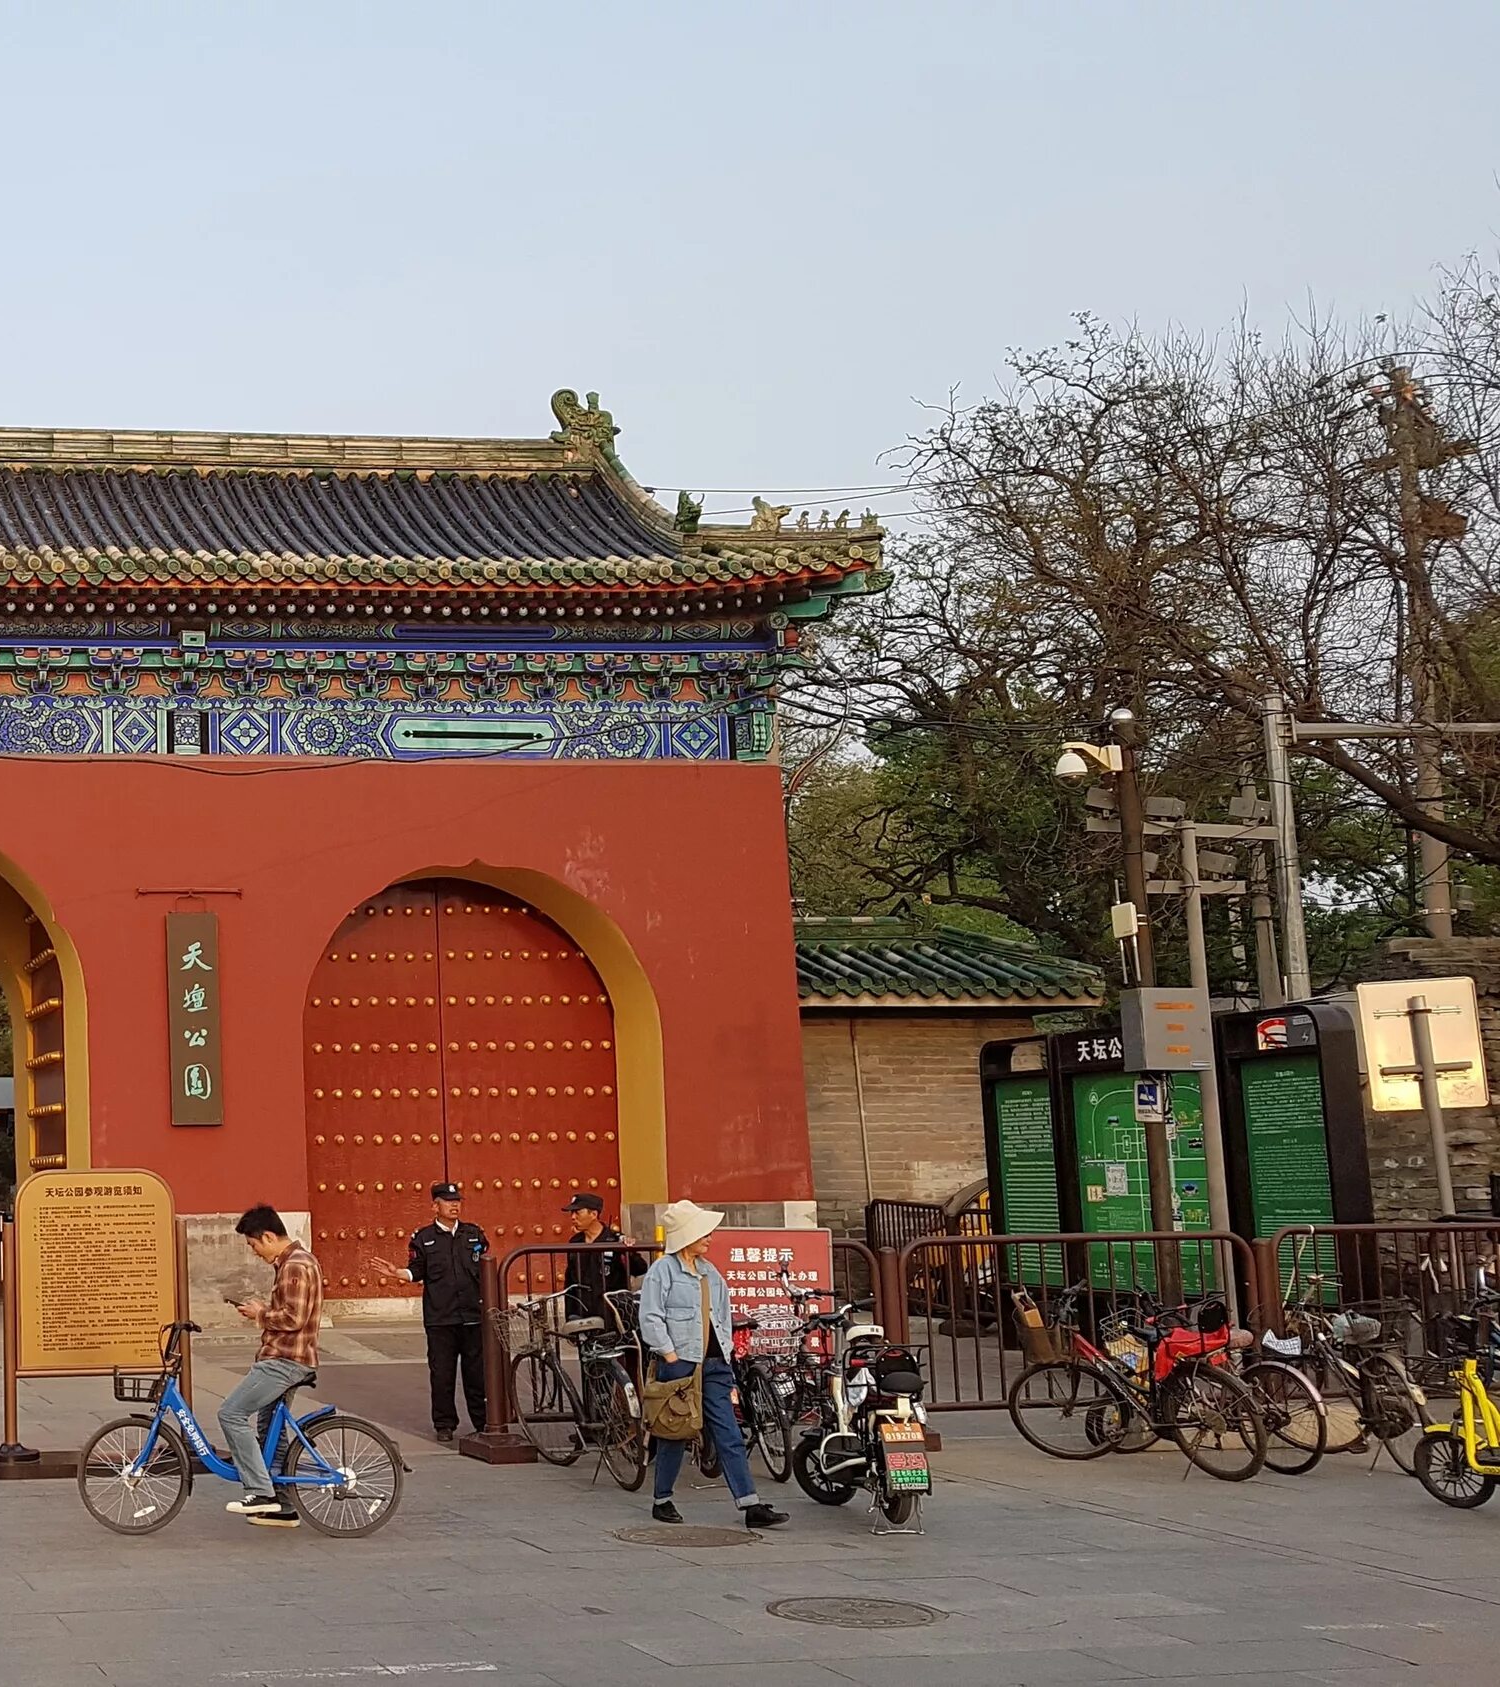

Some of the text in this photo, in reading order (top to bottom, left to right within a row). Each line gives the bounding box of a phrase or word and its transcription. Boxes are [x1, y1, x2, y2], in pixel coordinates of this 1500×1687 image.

[45, 1186, 143, 1198] 天坛公园参观游览须知
[730, 1247, 794, 1263] 温馨提示
[726, 1270, 819, 1282] 天坛公园已止办理
